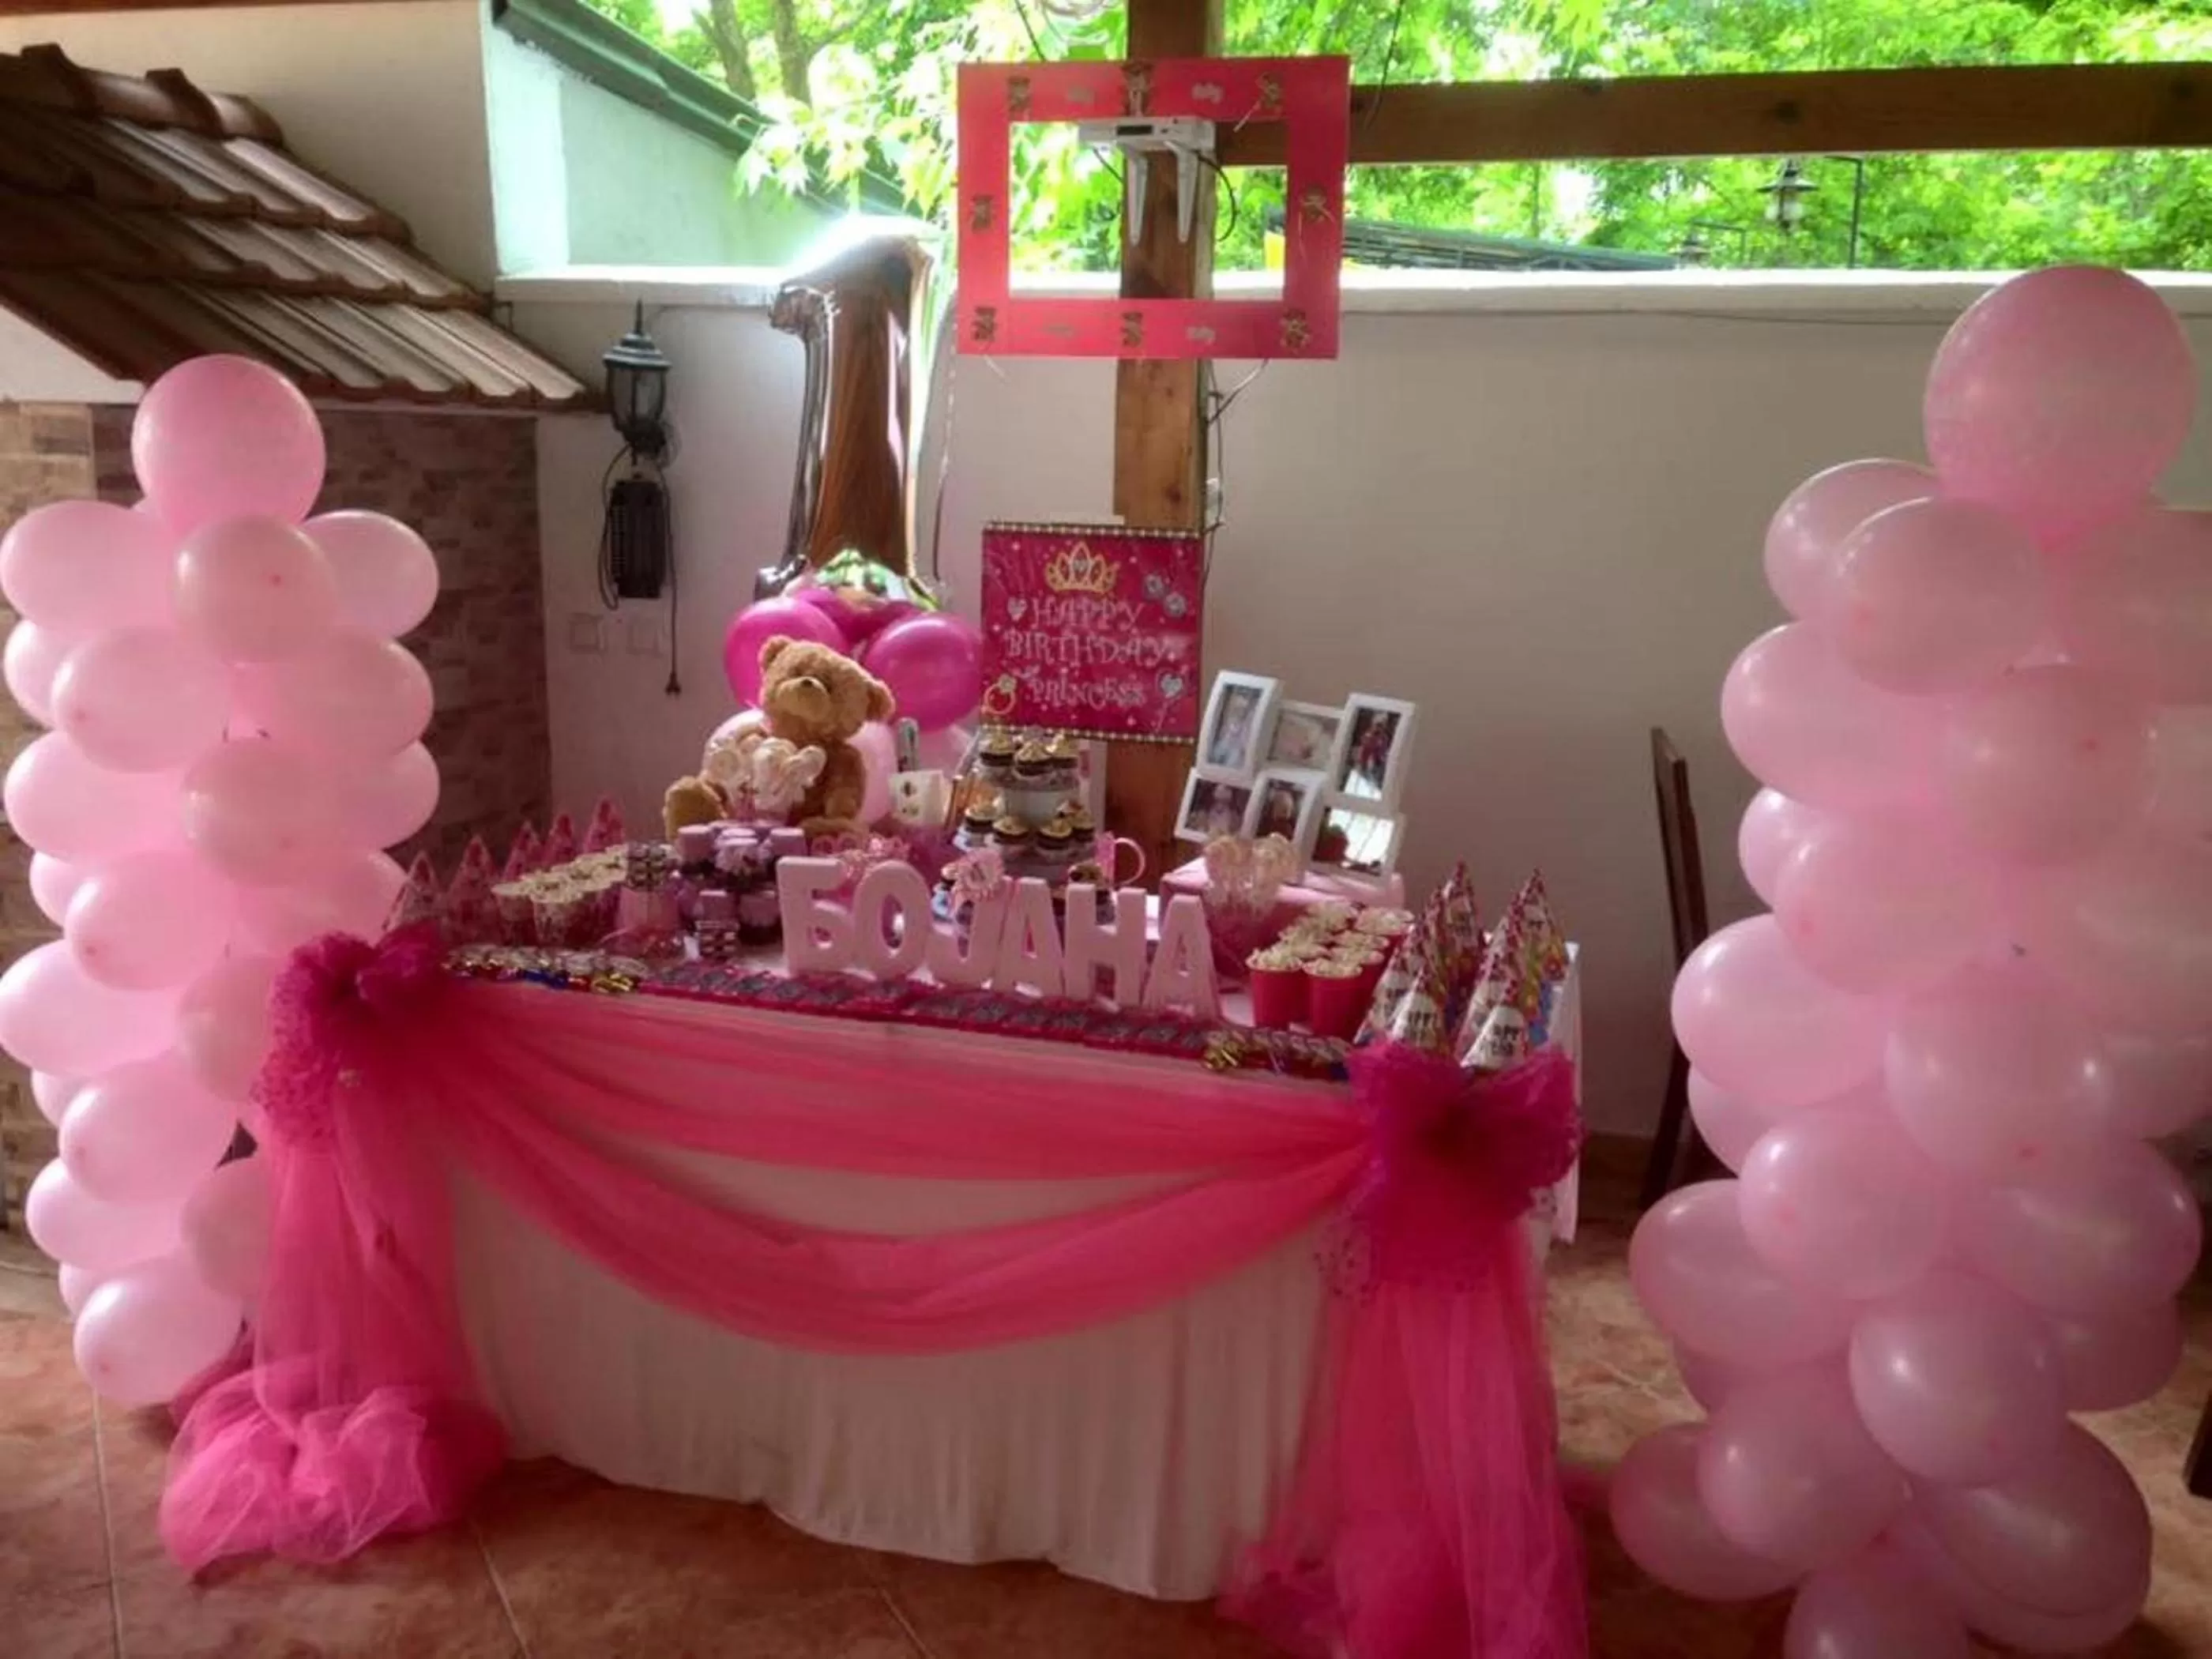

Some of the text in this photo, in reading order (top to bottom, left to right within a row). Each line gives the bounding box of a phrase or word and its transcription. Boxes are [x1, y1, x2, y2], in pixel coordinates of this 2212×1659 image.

[756, 218, 938, 605] 1
[1031, 593, 1145, 632] HAPPY
[1004, 631, 1168, 667] BIRTHDAY
[1027, 676, 1146, 709] PRINCESS
